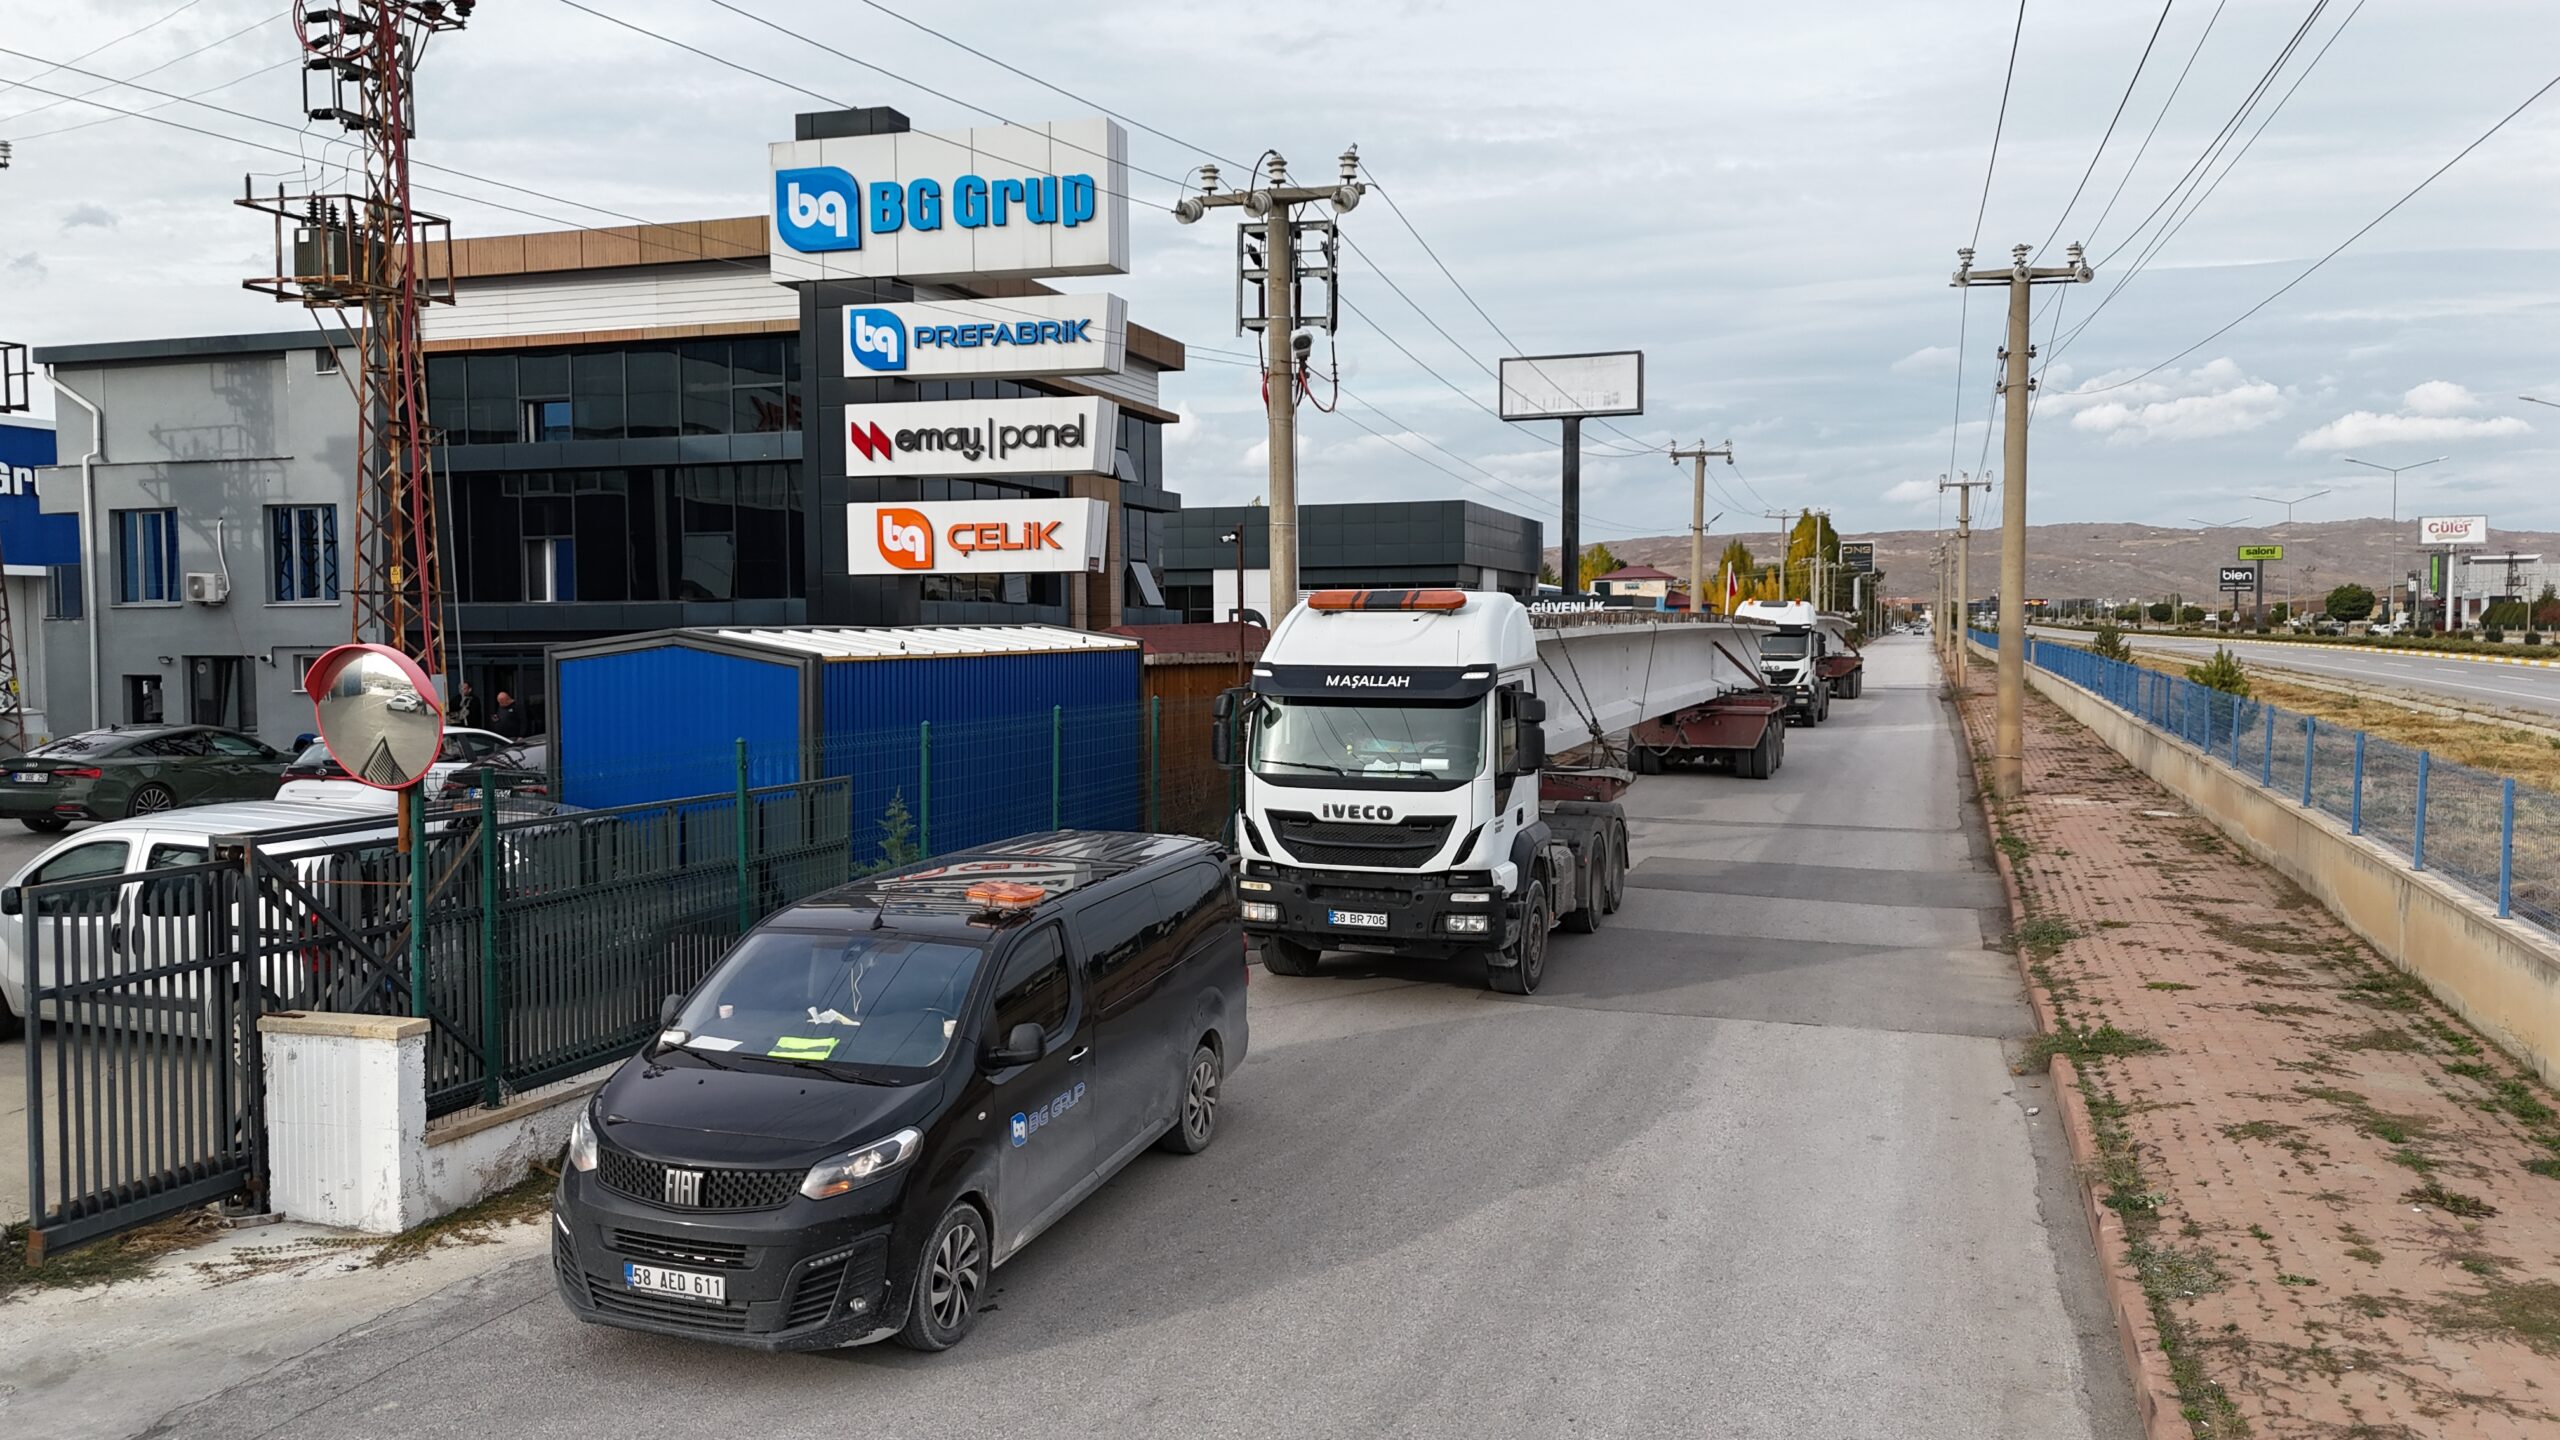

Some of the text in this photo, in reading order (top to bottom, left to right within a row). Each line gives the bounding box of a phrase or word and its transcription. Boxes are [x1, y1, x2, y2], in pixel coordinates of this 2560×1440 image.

[870, 177, 942, 234] BG
[953, 174, 1096, 232] Grup
[999, 413, 1086, 460] panel
[2428, 521, 2472, 534] Güler
[2222, 570, 2252, 580] bien
[1531, 598, 1605, 614] GÜVENLİK
[1326, 674, 1410, 689] MAŞALLAH
[1322, 803, 1394, 821] IVECO
[1349, 913, 1365, 924] BR
[1366, 915, 1386, 926] 706
[1028, 1104, 1049, 1134] BG
[1051, 1081, 1086, 1118] GRUP
[664, 1169, 704, 1206] FIAT
[633, 1267, 651, 1286] 58
[660, 1271, 686, 1291] AED
[694, 1276, 720, 1297] 611
